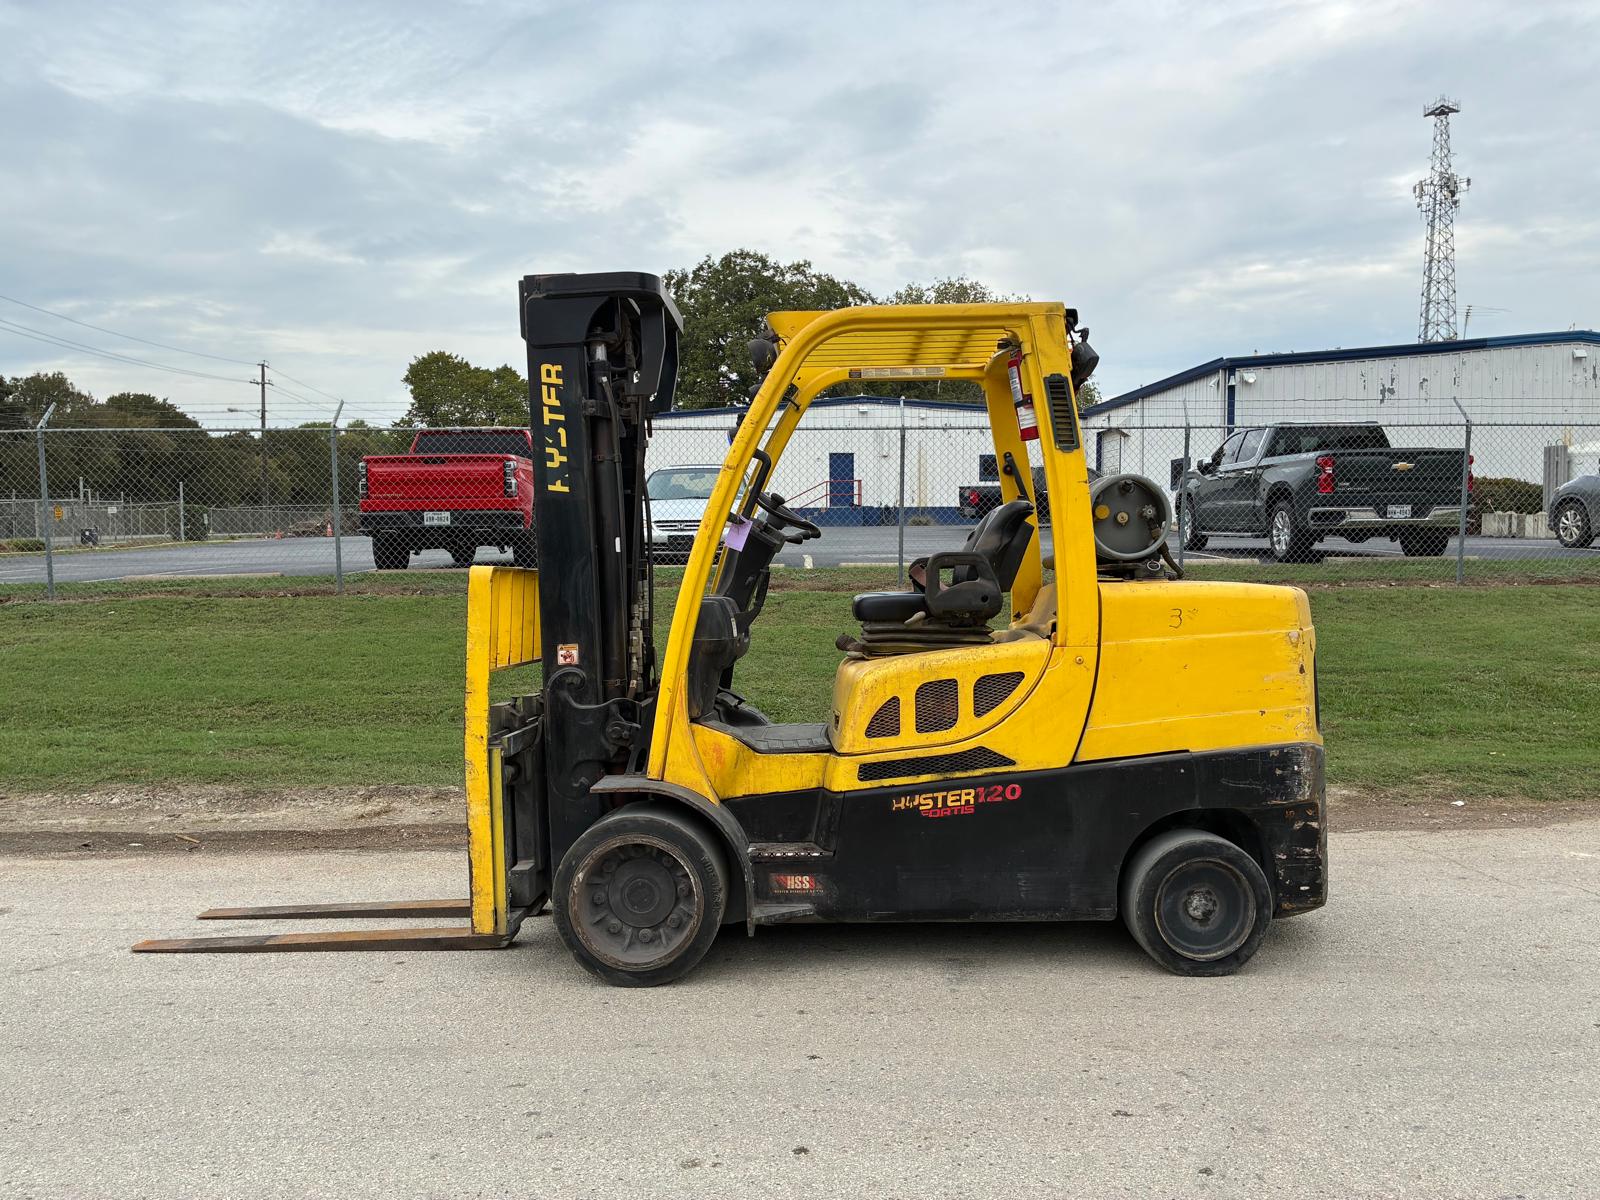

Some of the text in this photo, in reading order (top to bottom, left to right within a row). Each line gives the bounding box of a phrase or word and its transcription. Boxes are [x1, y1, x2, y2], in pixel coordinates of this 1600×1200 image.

[1168, 608, 1183, 629] 3
[976, 783, 1022, 803] 120
[920, 805, 975, 818] FORTIS
